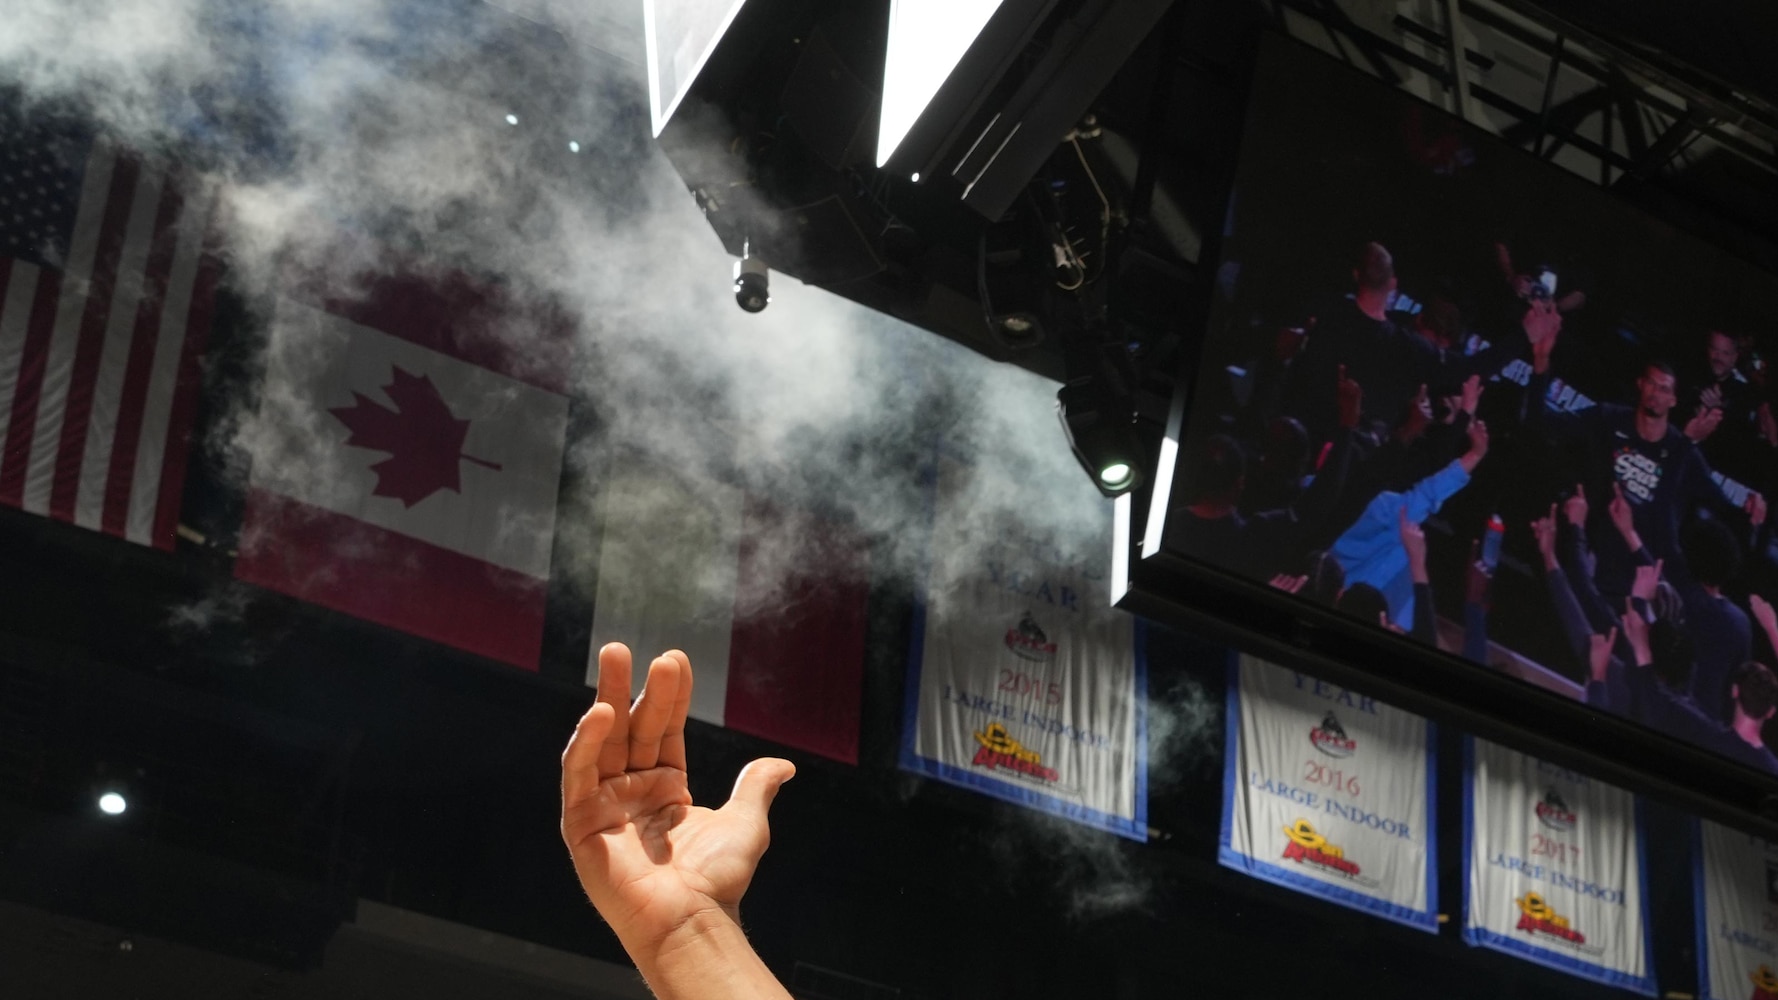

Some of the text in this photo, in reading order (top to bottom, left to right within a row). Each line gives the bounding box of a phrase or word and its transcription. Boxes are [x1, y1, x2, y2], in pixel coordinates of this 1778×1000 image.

[944, 685, 1017, 719] LARGE
[999, 668, 1062, 704] 2015
[1304, 759, 1361, 797] 2016
[1251, 771, 1411, 839] LARGE INDOOR
[1531, 833, 1580, 869] 2017
